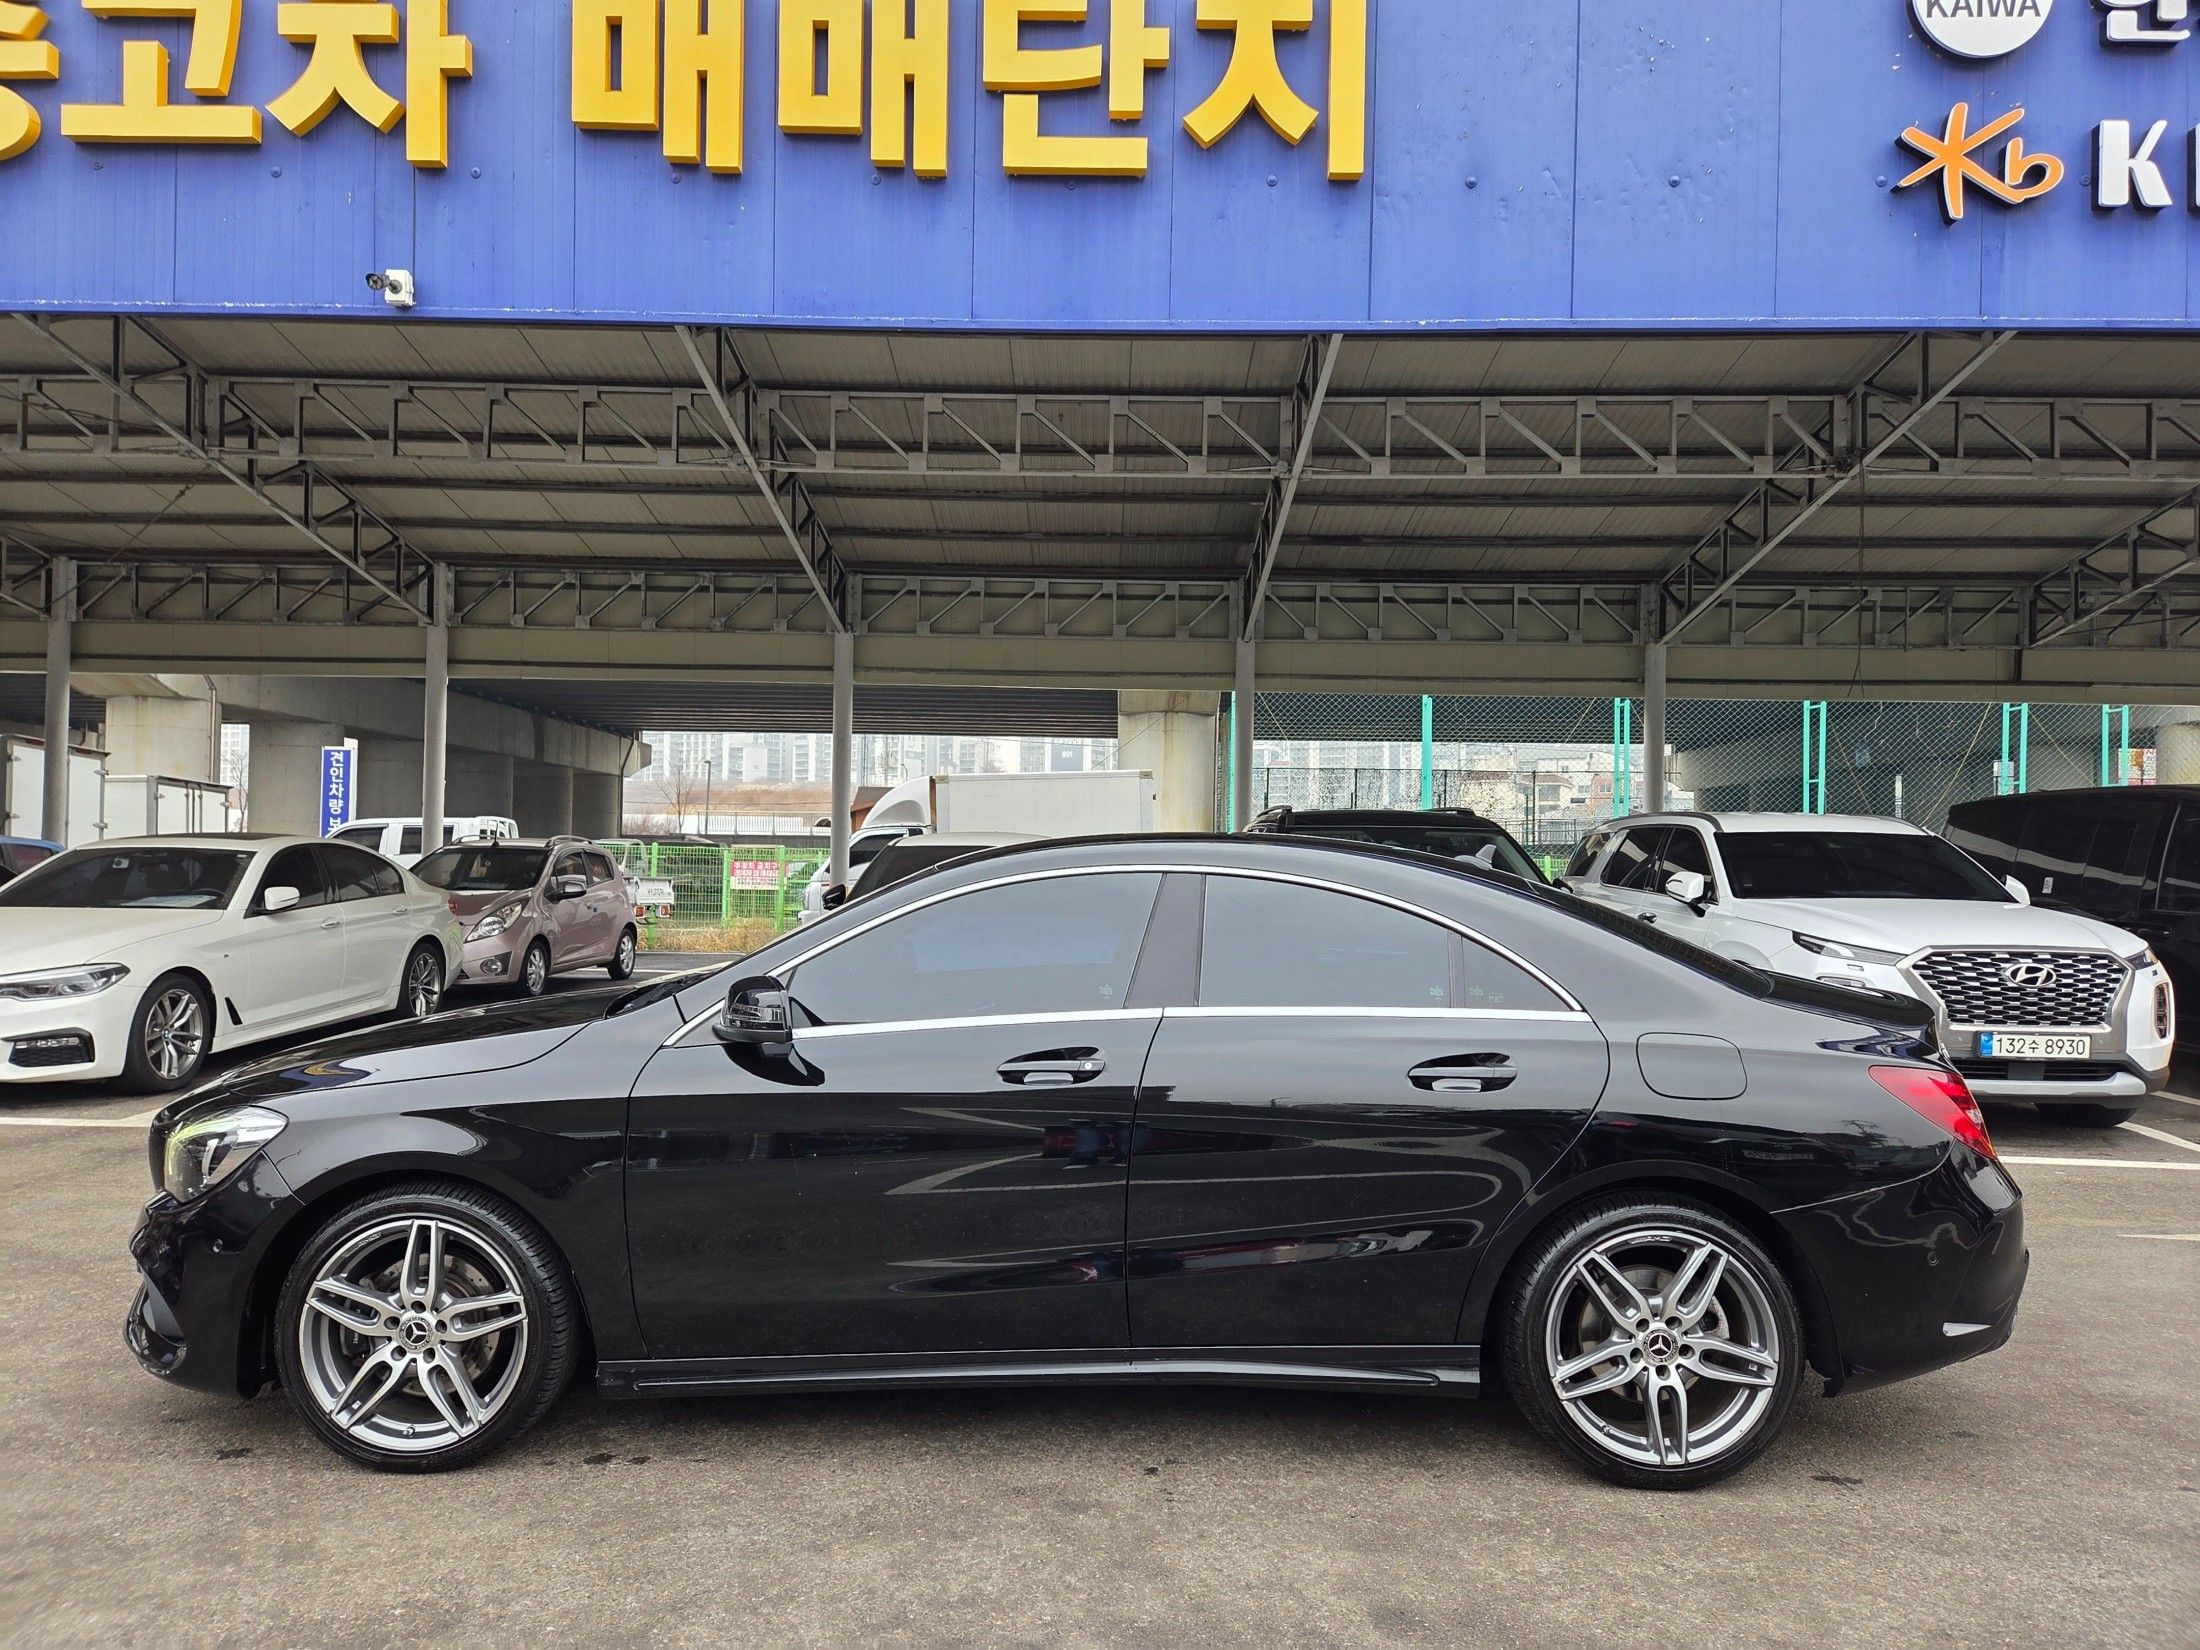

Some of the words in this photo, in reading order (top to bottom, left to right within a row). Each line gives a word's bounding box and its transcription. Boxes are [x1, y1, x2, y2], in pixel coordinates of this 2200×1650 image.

[1926, 0, 2041, 18] KAIWA
[0, 0, 473, 169] 고차
[571, 0, 1366, 181] 매매단지
[2099, 120, 2200, 207] K
[329, 752, 345, 815] 견인차량
[1996, 1037, 2040, 1054] 132수
[2044, 1038, 2086, 1055] 8930
